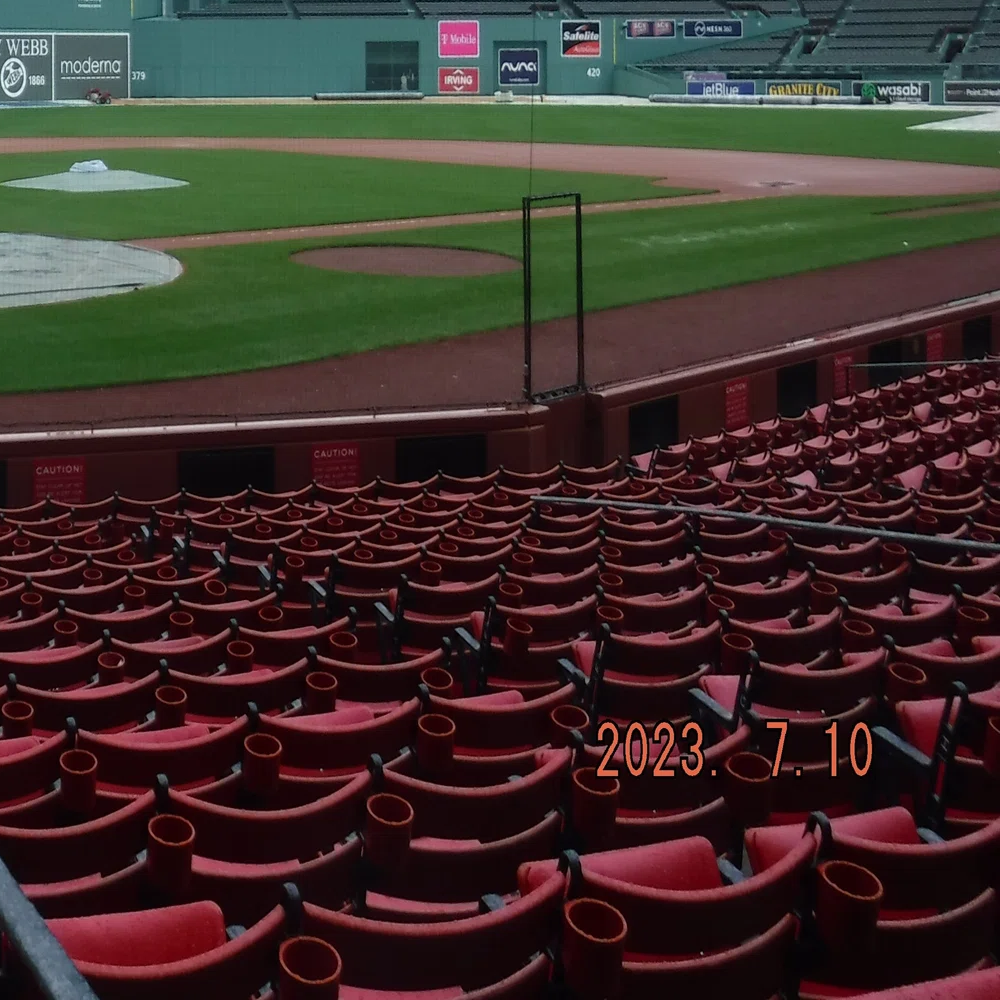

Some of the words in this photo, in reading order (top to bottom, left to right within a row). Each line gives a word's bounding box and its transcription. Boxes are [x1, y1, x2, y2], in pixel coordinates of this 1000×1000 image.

[450, 34, 476, 44] Mobile
[563, 31, 599, 41] Safelite
[6, 38, 49, 56] WEBB
[60, 56, 122, 74] moderna
[501, 61, 537, 72] nuna
[131, 71, 146, 80] 379
[586, 67, 601, 77] 420
[28, 75, 45, 86] 1866
[444, 75, 473, 85] IRVING
[703, 83, 739, 96] jetBlue
[769, 83, 814, 95] GRANITE
[877, 83, 922, 96] wasabi
